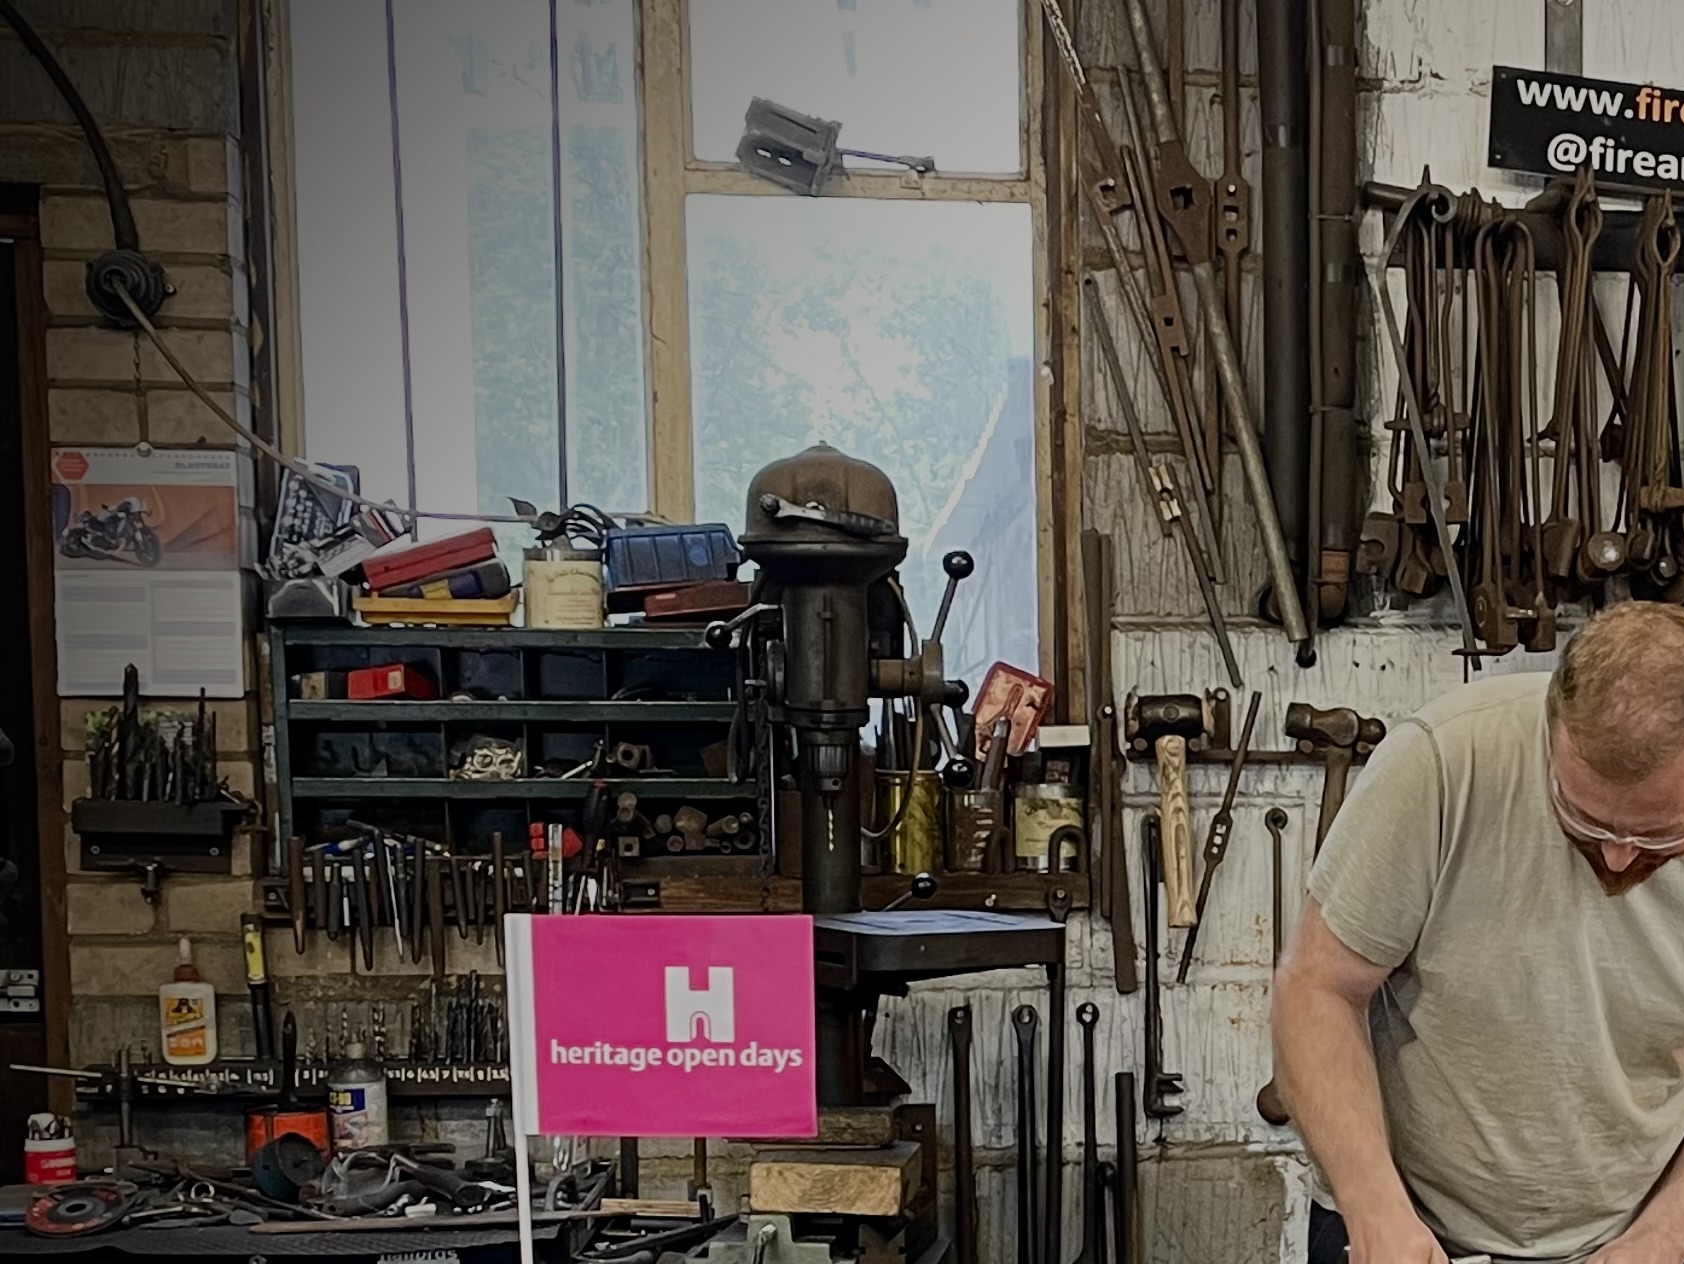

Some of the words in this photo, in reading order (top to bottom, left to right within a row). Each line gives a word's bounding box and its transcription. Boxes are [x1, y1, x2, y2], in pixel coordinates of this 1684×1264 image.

[551, 1039, 662, 1071] heritage
[666, 1047, 735, 1072] open
[739, 1041, 803, 1073] days
